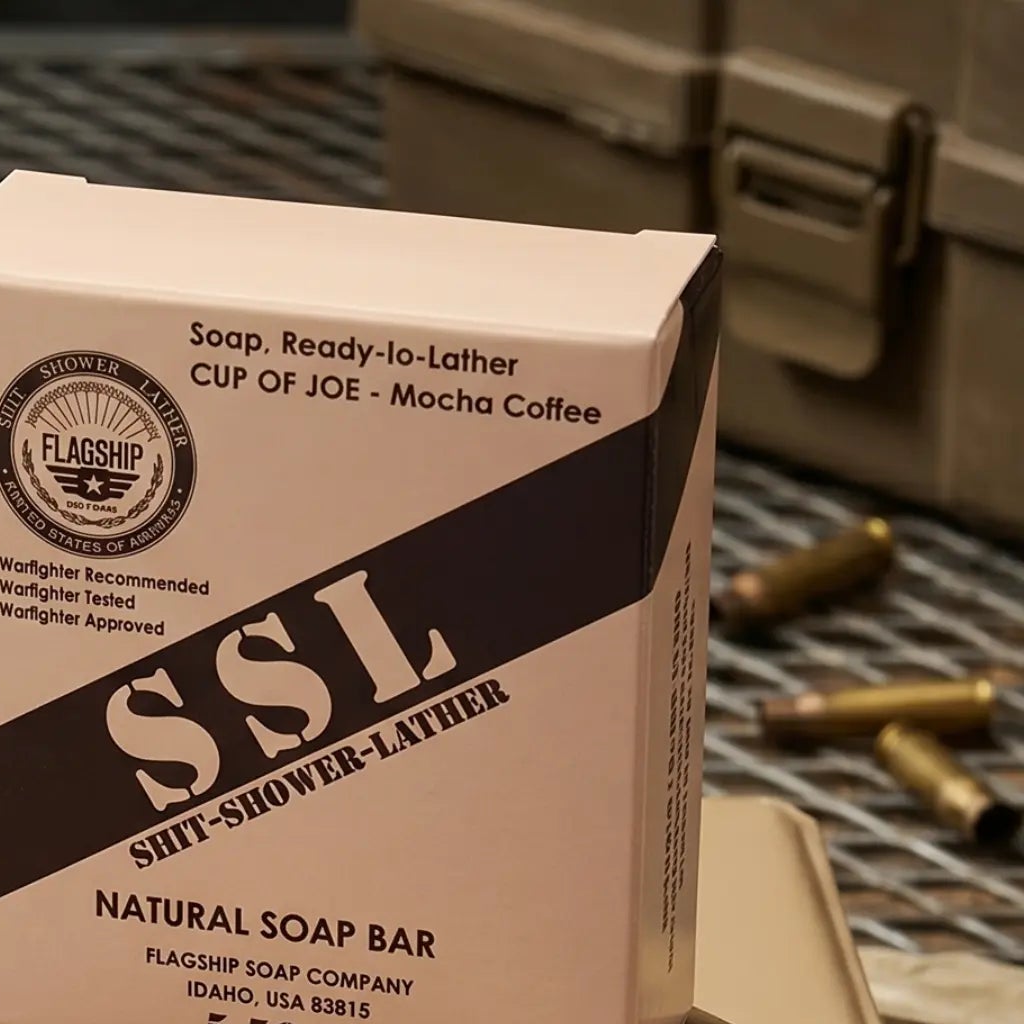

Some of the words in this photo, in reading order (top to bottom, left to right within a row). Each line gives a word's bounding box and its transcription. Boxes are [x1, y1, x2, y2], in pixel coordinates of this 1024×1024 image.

[189, 322, 271, 357] Soap,
[39, 355, 121, 380] SHOWER
[138, 378, 189, 449] LATHER
[190, 362, 248, 391] CUP
[257, 368, 297, 395] OF
[304, 374, 361, 402] JOE
[389, 382, 494, 416] Mocha
[502, 393, 603, 426] Coffee
[41, 432, 145, 471] FLAGSHIP
[47, 527, 103, 554] STATES
[106, 541, 126, 554] OF
[0, 578, 80, 604] Warfighter
[84, 589, 136, 610] Tested
[84, 566, 210, 597] Recommended
[84, 612, 166, 637] Approved
[105, 570, 458, 812] SSL
[128, 677, 511, 870] SHIT-SHOWER-LATHER
[94, 888, 251, 937] NATURAL
[259, 910, 357, 948] SOAP
[367, 923, 438, 959] BAR
[145, 946, 240, 975] FLAGSHIP
[244, 959, 302, 983] SOAP
[306, 967, 415, 997] COMPANY
[186, 980, 260, 1008] IDAHO,
[265, 989, 306, 1013] USA
[310, 996, 372, 1020] 83815
